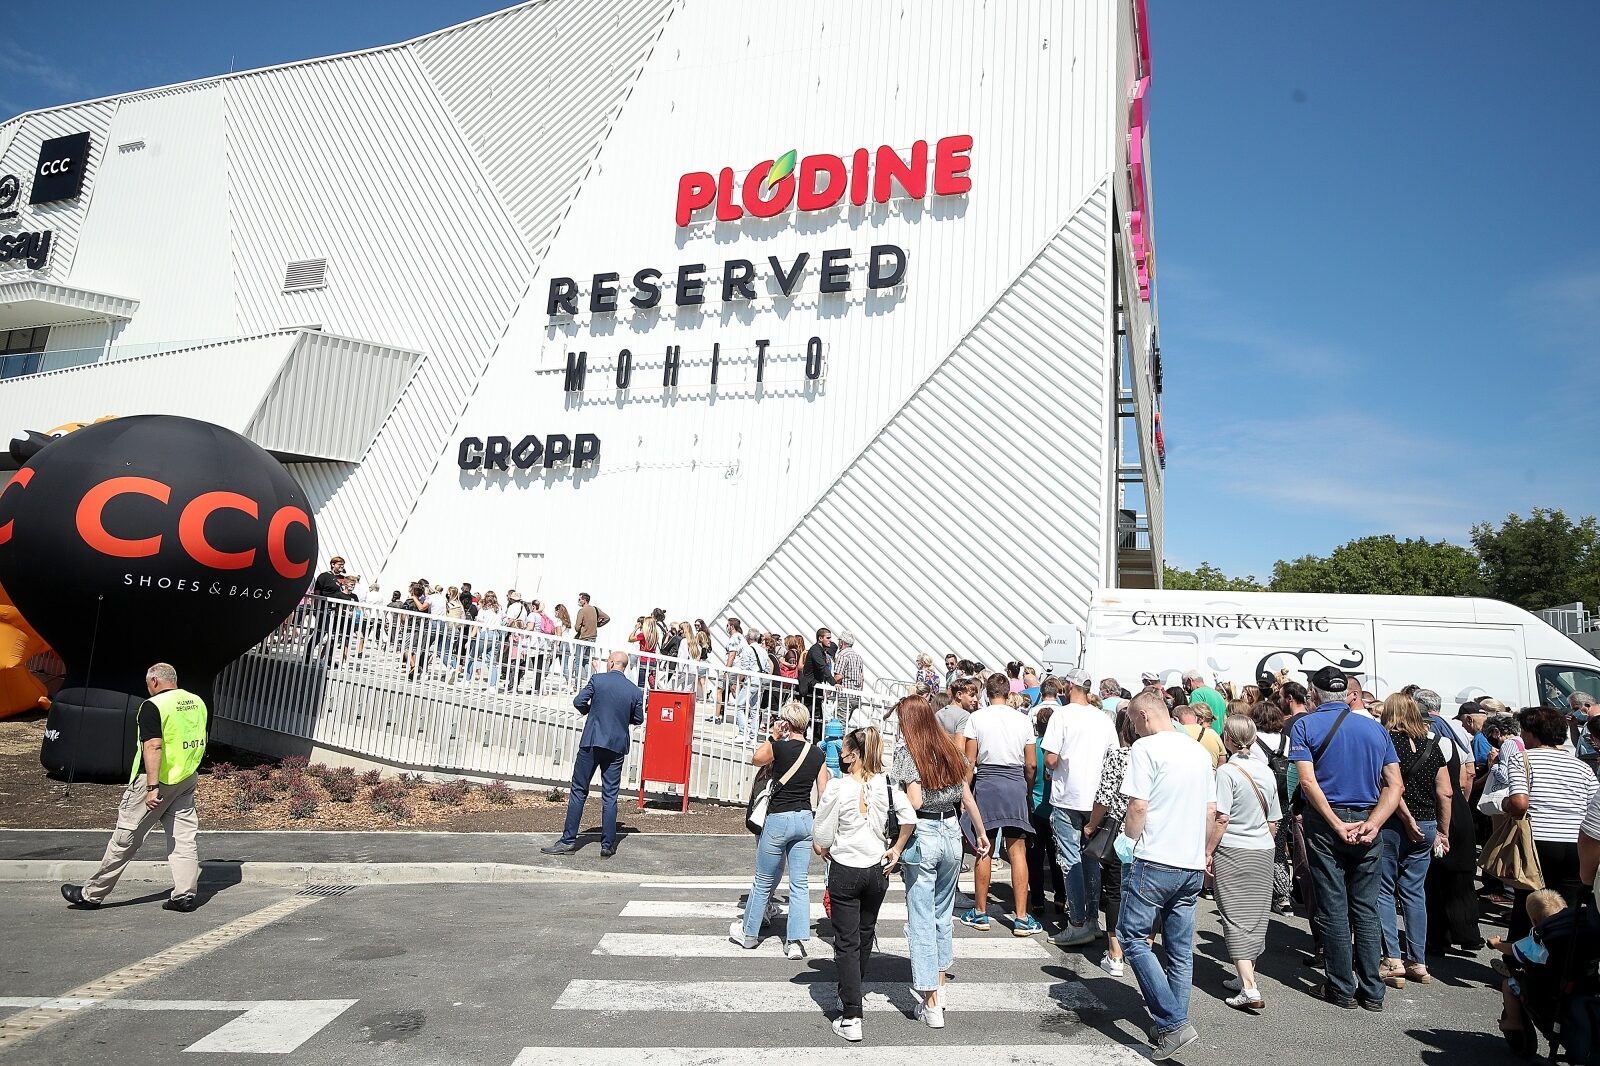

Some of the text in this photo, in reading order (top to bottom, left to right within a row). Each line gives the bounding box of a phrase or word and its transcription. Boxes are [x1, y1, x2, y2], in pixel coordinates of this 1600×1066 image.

[40, 158, 71, 176] CCC
[676, 135, 973, 228] PLODINE
[547, 244, 908, 316] RESERVED
[564, 336, 824, 392] MOHITO
[458, 433, 601, 470] CROPP
[75, 476, 311, 579] CCC
[124, 573, 273, 600] SHOES & BAGS
[1131, 610, 1229, 629] CATERING
